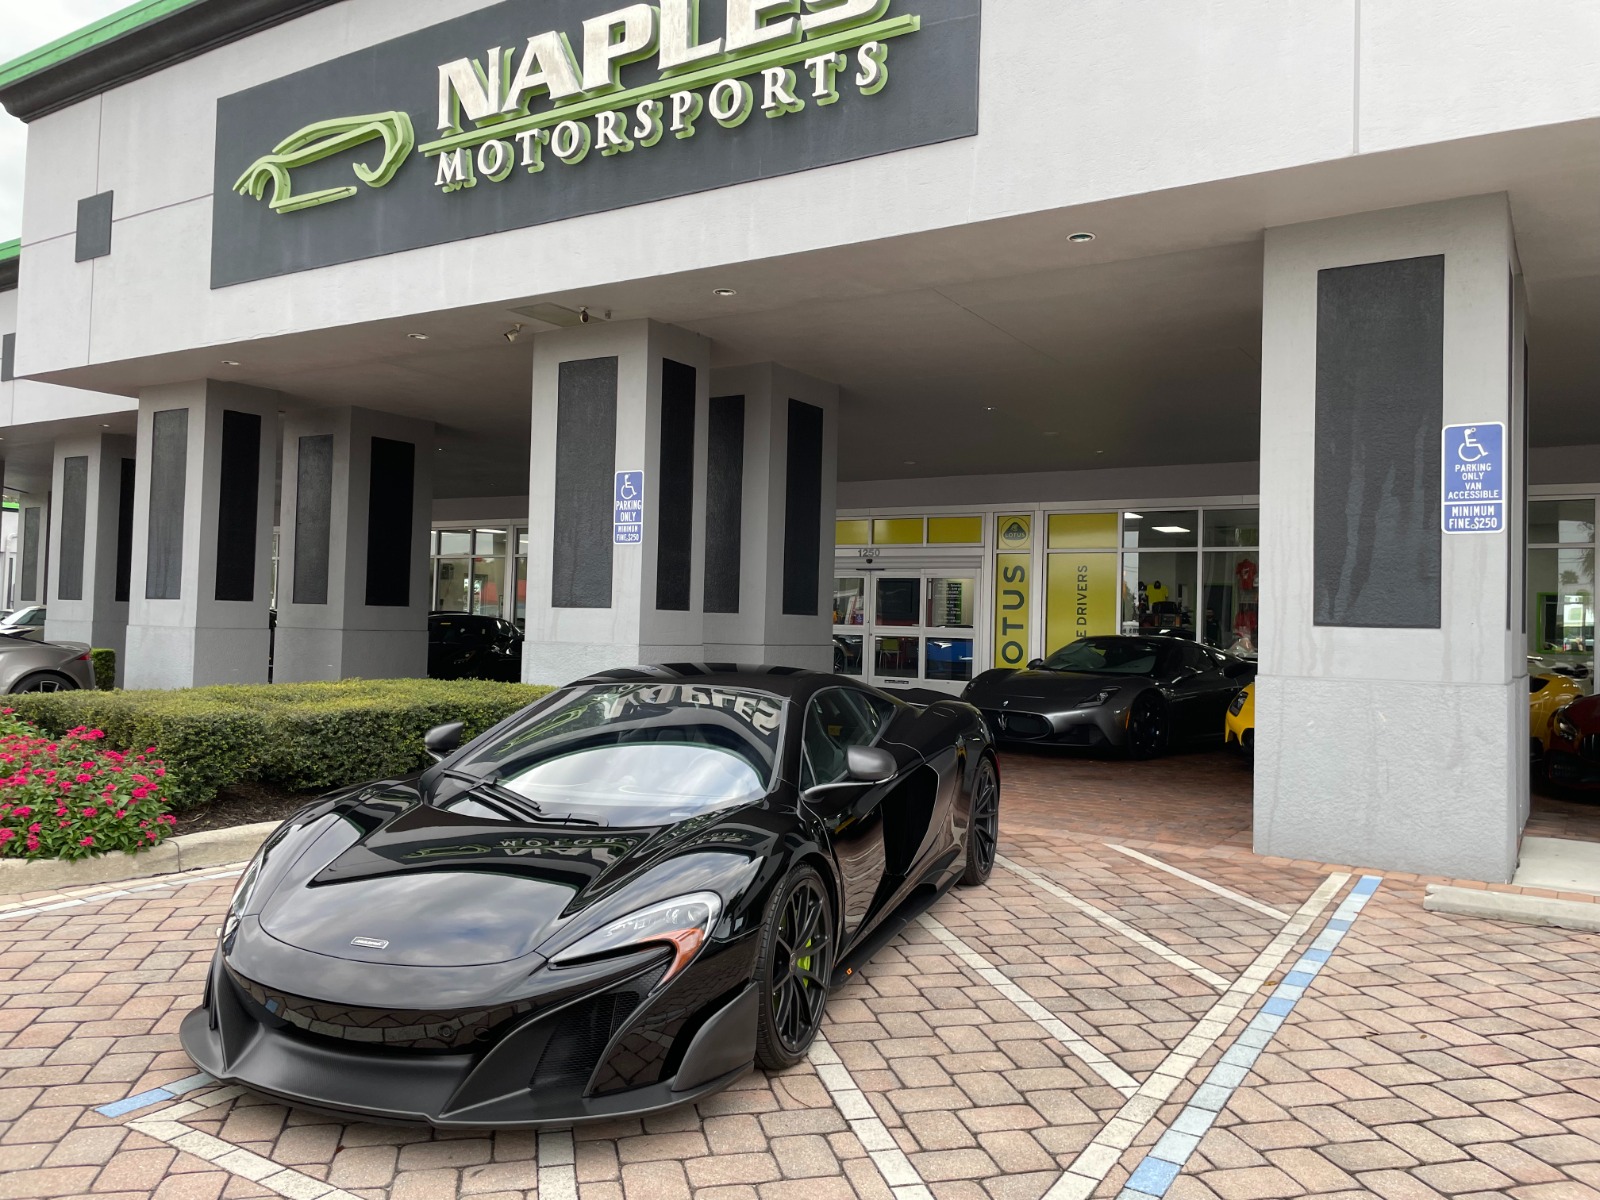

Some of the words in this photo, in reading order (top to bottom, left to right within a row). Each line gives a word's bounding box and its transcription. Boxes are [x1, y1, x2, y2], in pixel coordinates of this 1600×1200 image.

[434, 41, 884, 188] MOTORSPORTS
[1455, 463, 1492, 472] PARKING
[1462, 472, 1484, 480] ONLY
[1465, 482, 1482, 490] VAN
[1448, 490, 1499, 499] ACCESSIBLE
[615, 500, 642, 511] PARKING
[1452, 505, 1495, 517] MINIMUM
[620, 511, 637, 522] ONLY
[617, 525, 638, 533] MINIMUM
[1449, 518, 1471, 529] FINE
[1474, 517, 1498, 530] $250
[858, 548, 880, 557] 1250
[1076, 565, 1088, 626] DRIVERS
[1001, 565, 1026, 665] OTUS
